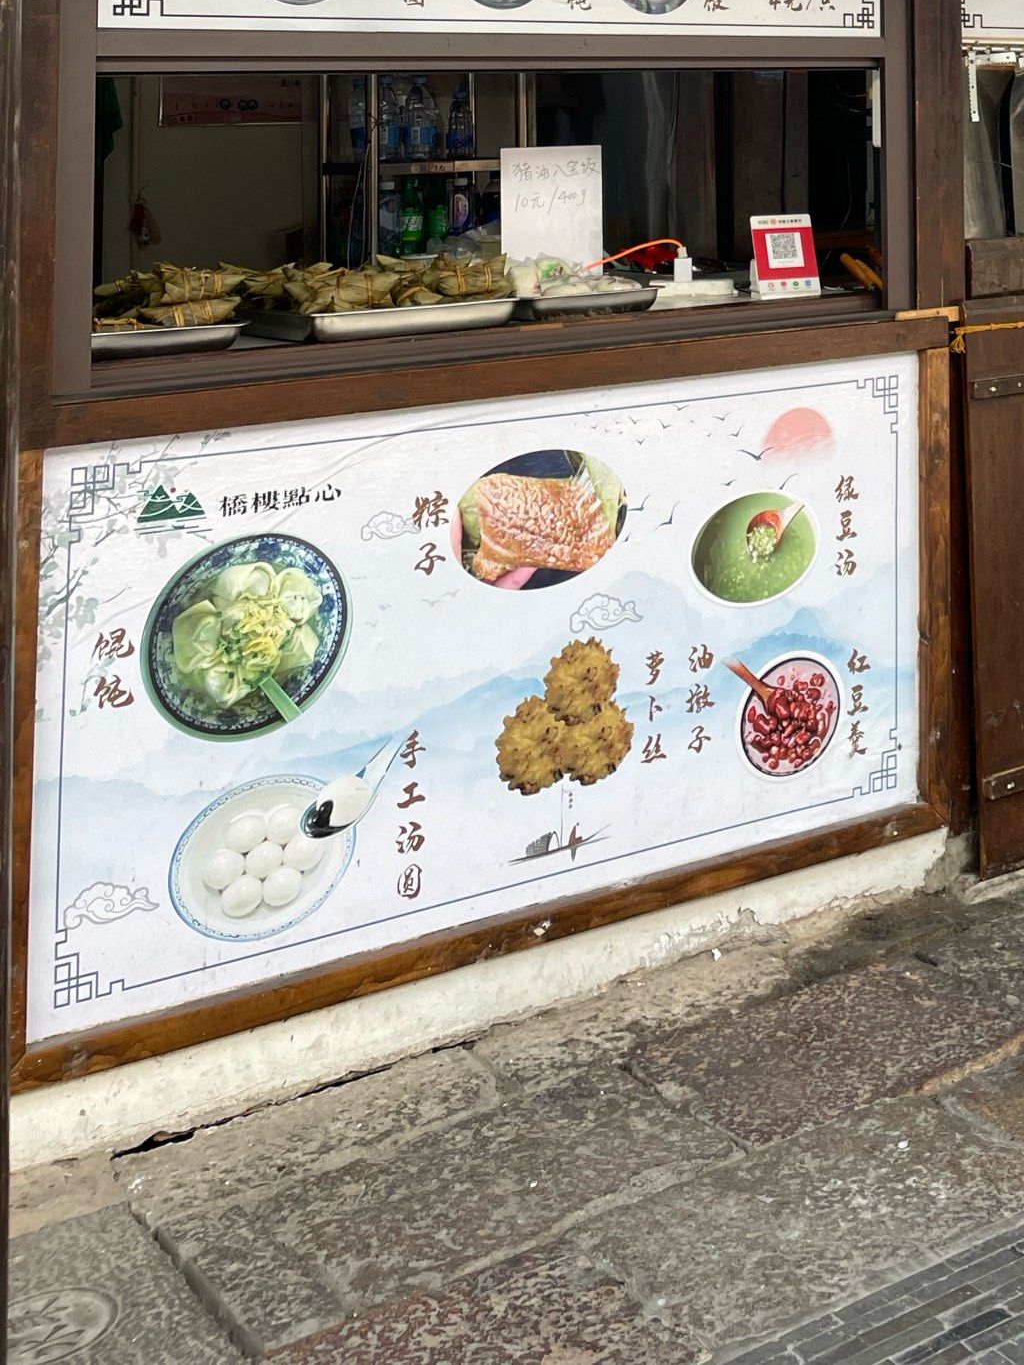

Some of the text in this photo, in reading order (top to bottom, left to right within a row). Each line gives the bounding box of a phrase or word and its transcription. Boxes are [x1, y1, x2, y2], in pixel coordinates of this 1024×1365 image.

[512, 158, 600, 183] 猪油八宝饭
[218, 483, 342, 518] 橋樓點心
[410, 490, 450, 576] 粽子
[834, 474, 860, 577] 绿豆汤
[92, 627, 135, 709] 馄饨
[641, 649, 667, 764] 萝卜丝
[846, 648, 872, 758] 红豆羹
[397, 729, 426, 900] 手工汤圆
